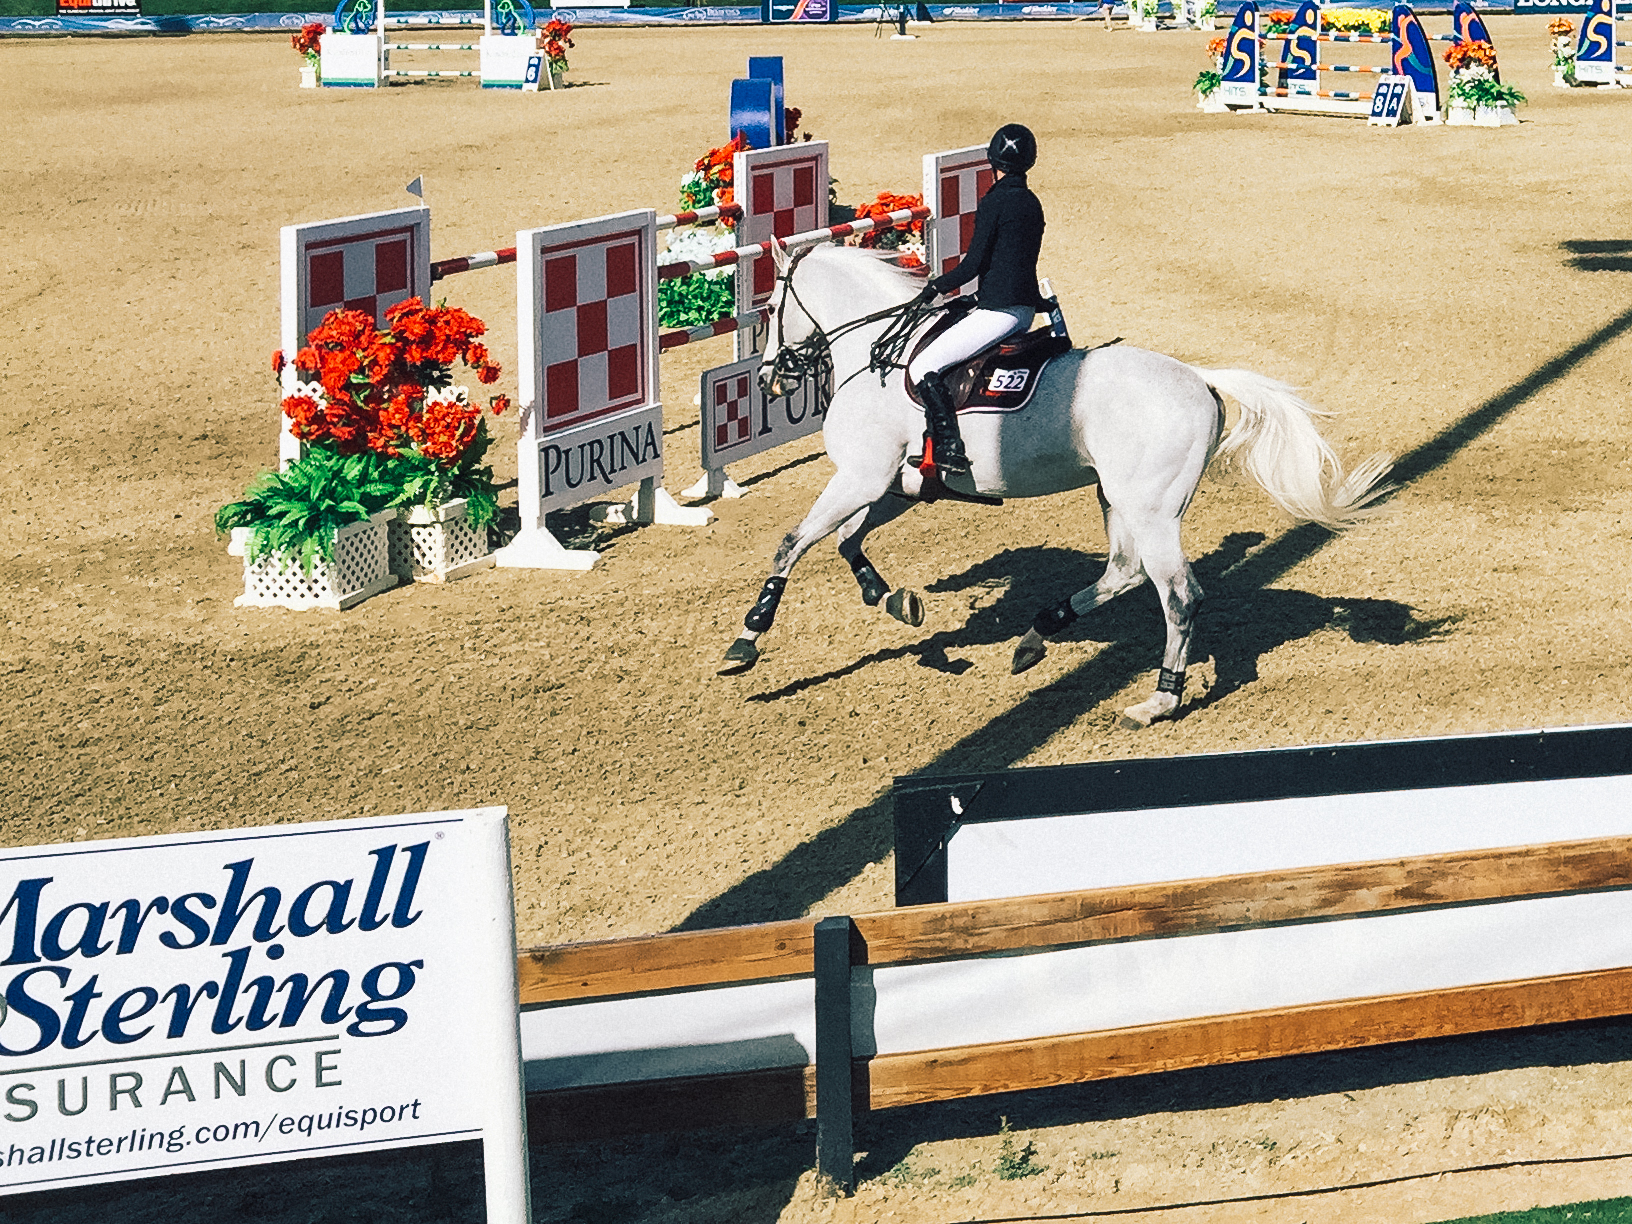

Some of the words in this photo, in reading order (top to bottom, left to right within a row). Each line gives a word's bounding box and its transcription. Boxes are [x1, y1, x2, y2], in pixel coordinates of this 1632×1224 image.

[1373, 95, 1384, 112] 8
[1388, 97, 1398, 110] A
[994, 375, 1025, 389] 522
[540, 421, 660, 498] PURINA
[0, 943, 424, 1057] Sterling
